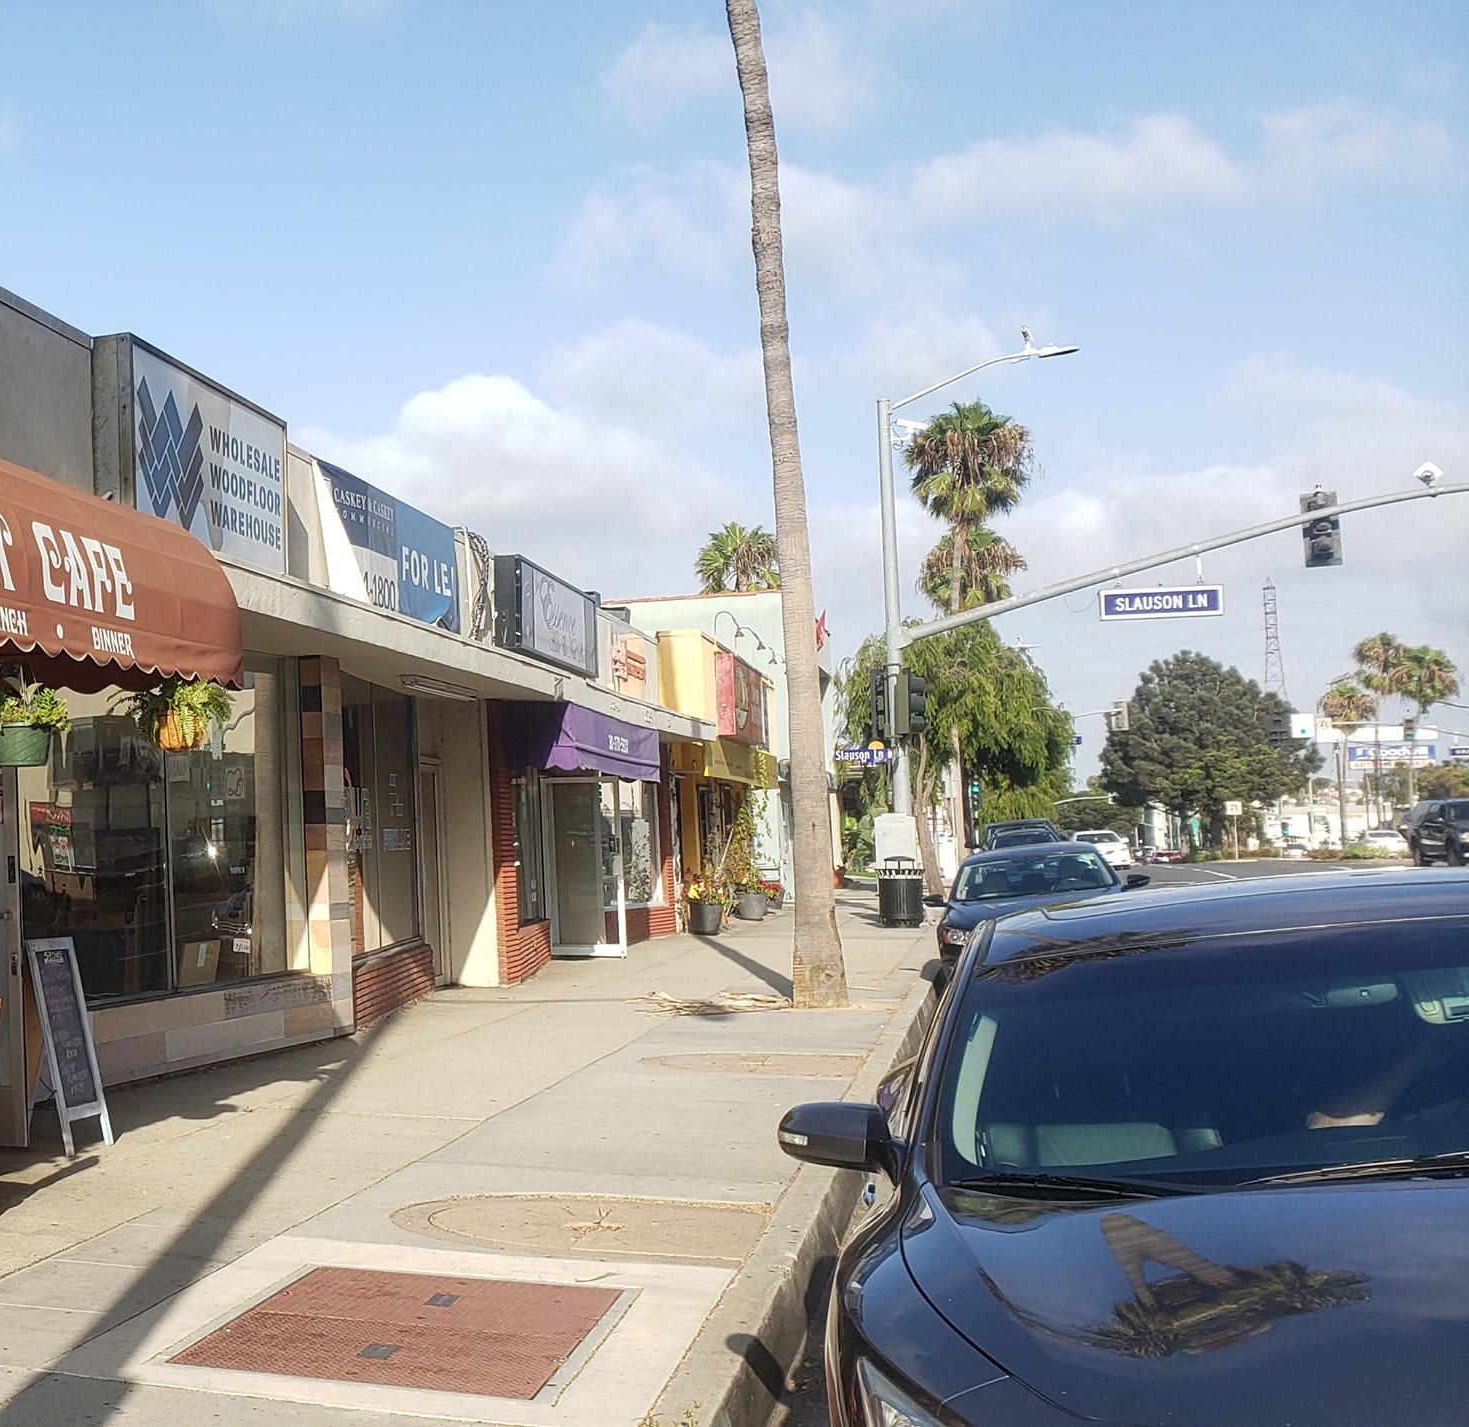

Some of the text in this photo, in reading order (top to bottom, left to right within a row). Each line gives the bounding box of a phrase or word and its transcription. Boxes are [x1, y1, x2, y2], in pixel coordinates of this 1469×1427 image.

[209, 425, 280, 483] WHOLESALE
[209, 462, 281, 518] WOODFLOOR
[334, 488, 367, 510] CASKEY
[373, 501, 394, 522] CASKEY
[210, 500, 281, 551] WAREHOUSE
[336, 508, 394, 536] OMMERCIAL
[32, 521, 135, 620] CAFE
[401, 545, 429, 591] FOR
[1115, 593, 1208, 612] SLAUSON LN
[92, 626, 134, 658] DINNER
[835, 750, 870, 761] Slauson
[874, 749, 884, 759] Ln
